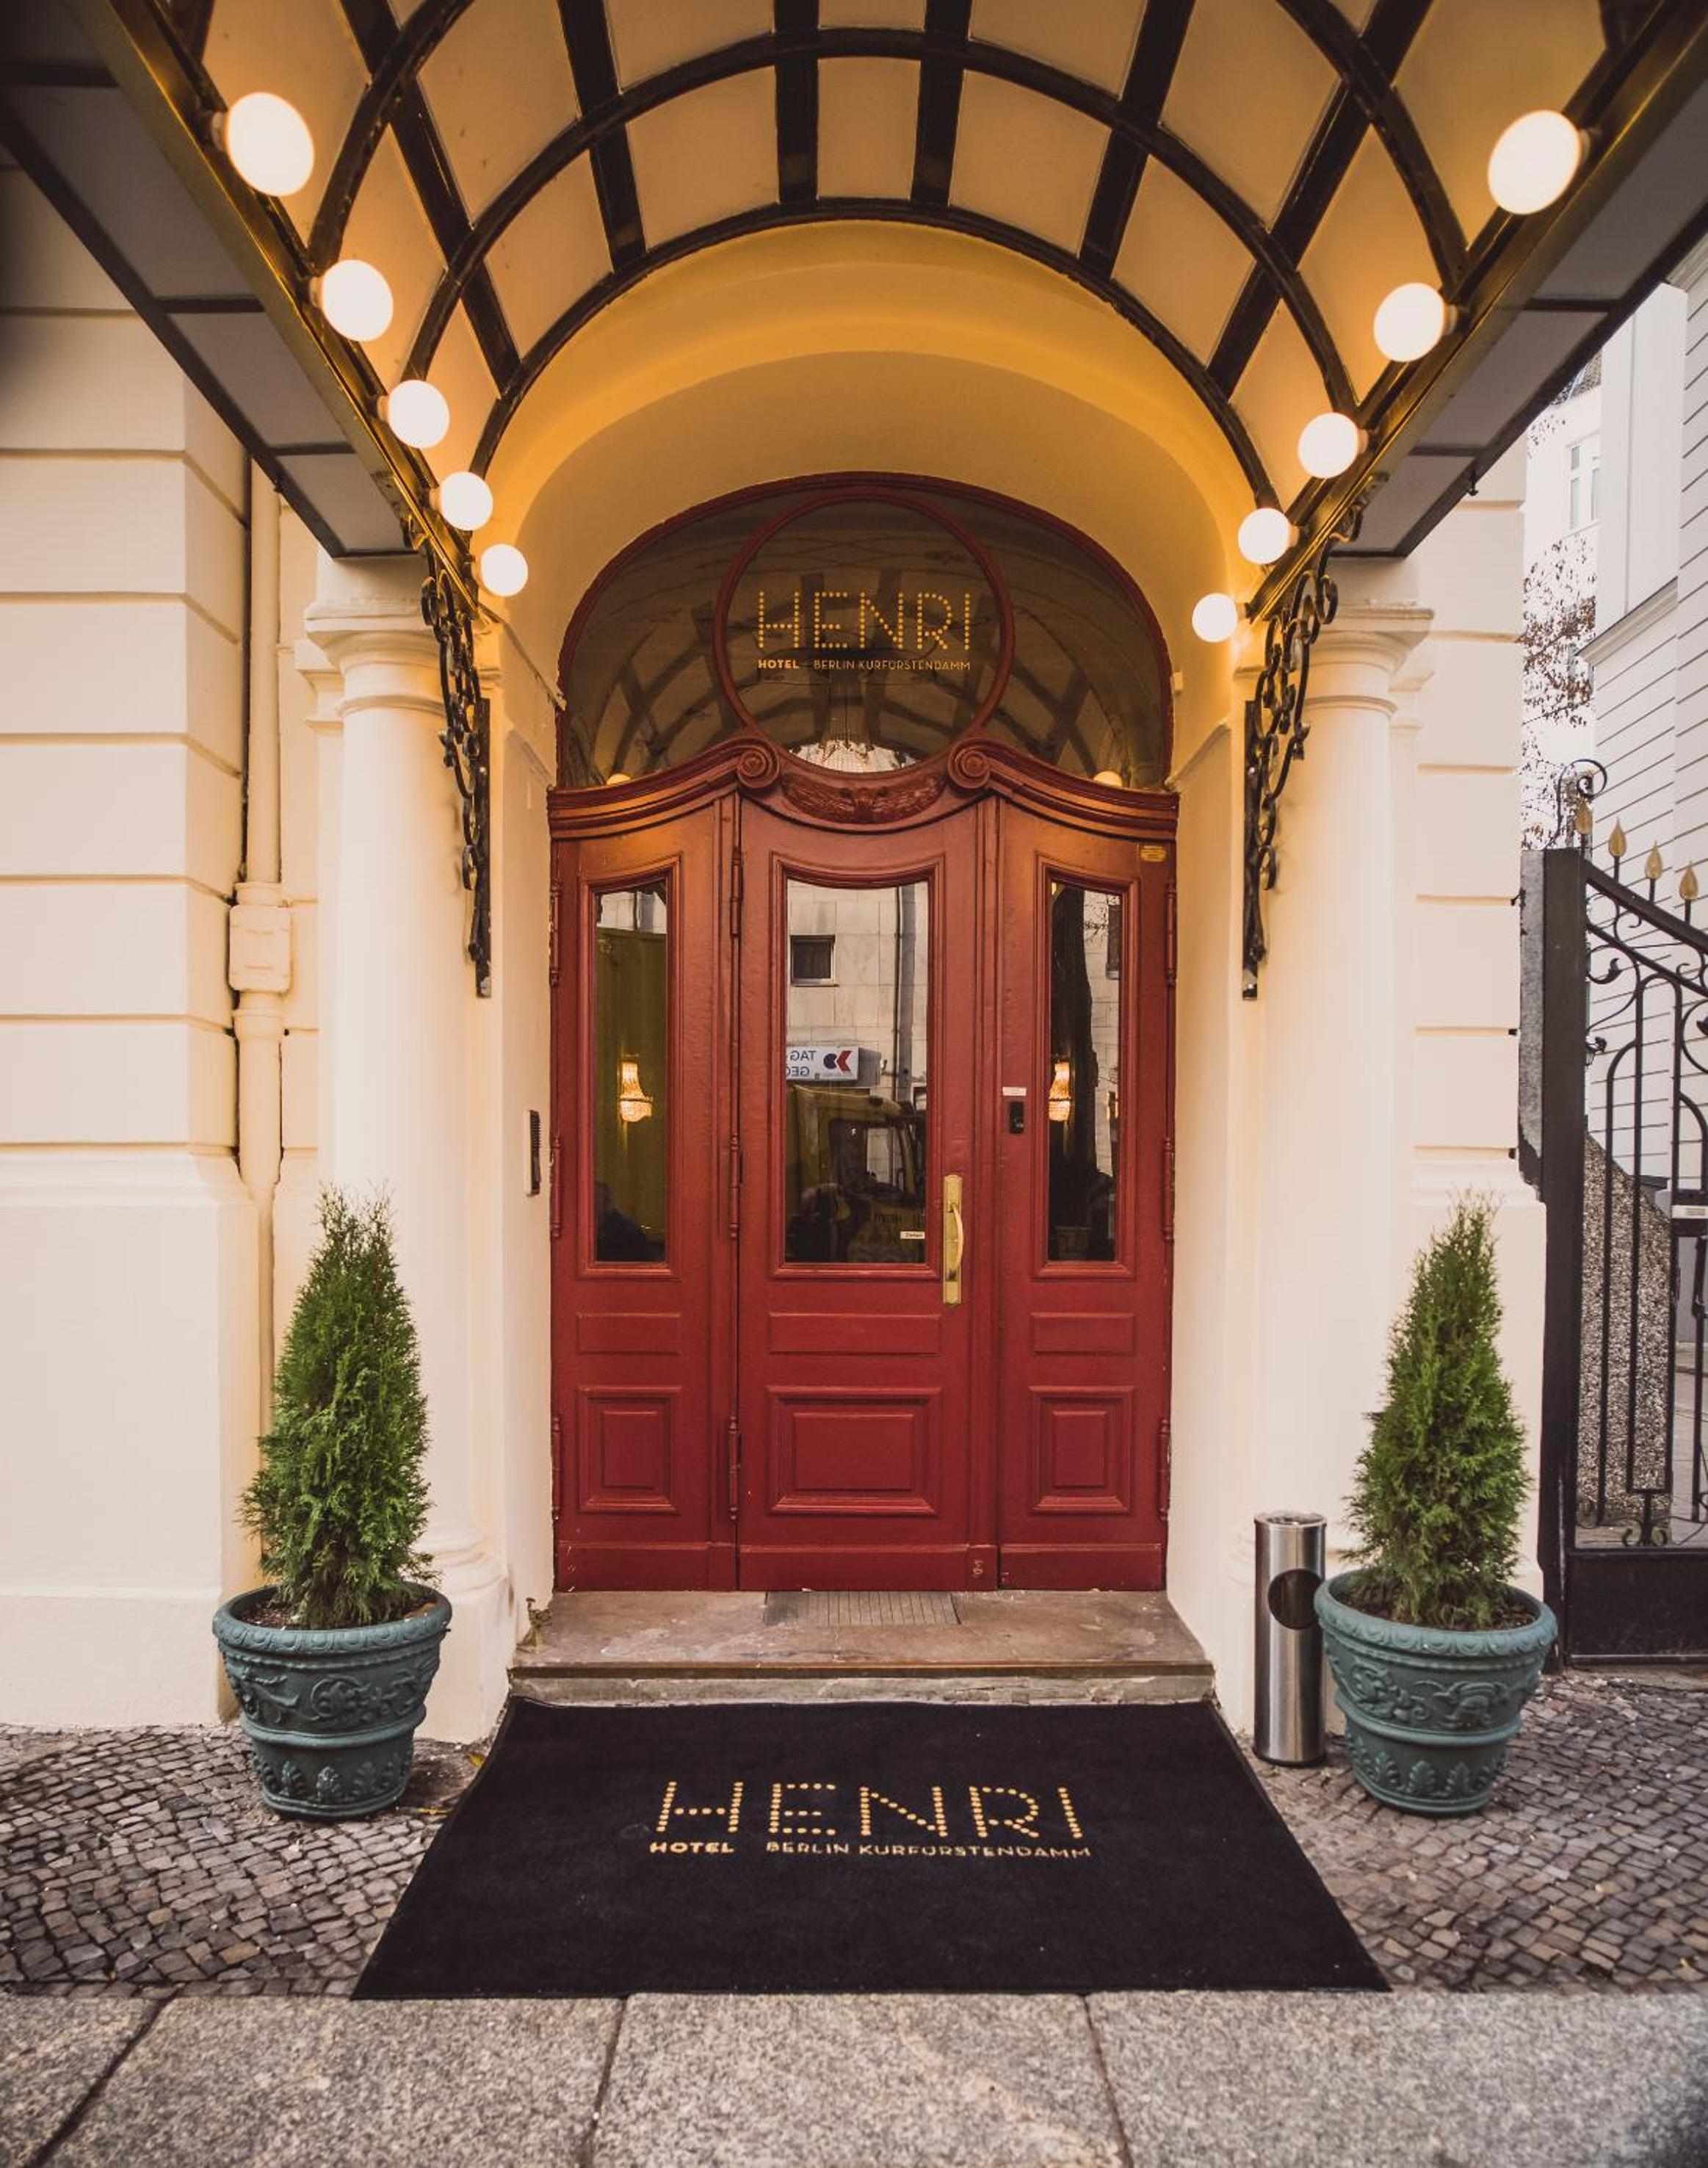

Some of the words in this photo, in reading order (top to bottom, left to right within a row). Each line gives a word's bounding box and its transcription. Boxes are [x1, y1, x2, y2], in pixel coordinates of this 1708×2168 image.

[758, 591, 971, 650] HENRI
[758, 660, 800, 669] HOTEL
[814, 660, 855, 670] BERLIN
[656, 1781, 1083, 1838] HENRI
[650, 1842, 735, 1854] HOTEL
[767, 1842, 850, 1854] BERLIN
